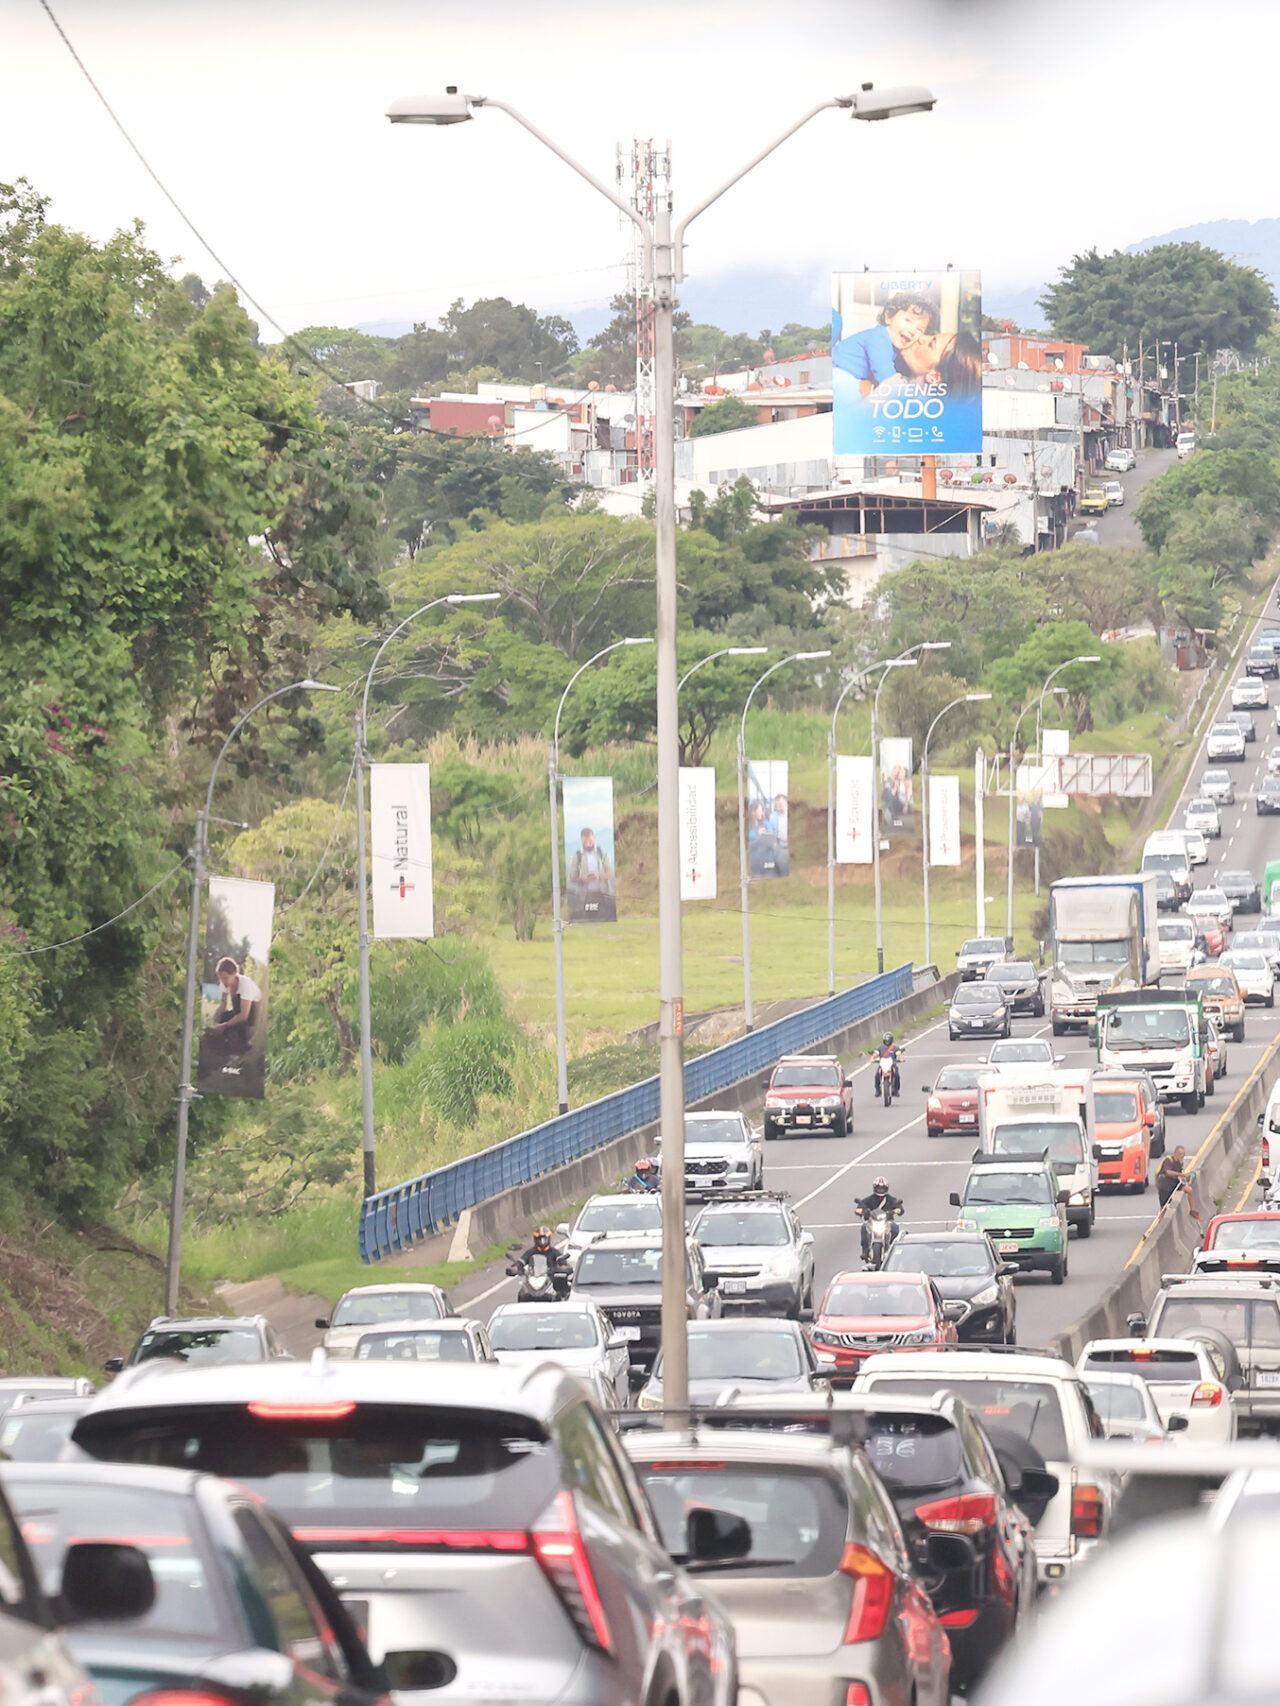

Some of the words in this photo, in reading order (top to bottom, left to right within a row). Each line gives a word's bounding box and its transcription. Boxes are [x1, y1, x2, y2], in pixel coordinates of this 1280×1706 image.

[880, 280, 933, 291] LIBERTY
[869, 383, 892, 397] LO
[869, 398, 944, 419] TODO
[391, 805, 409, 870] Natural
